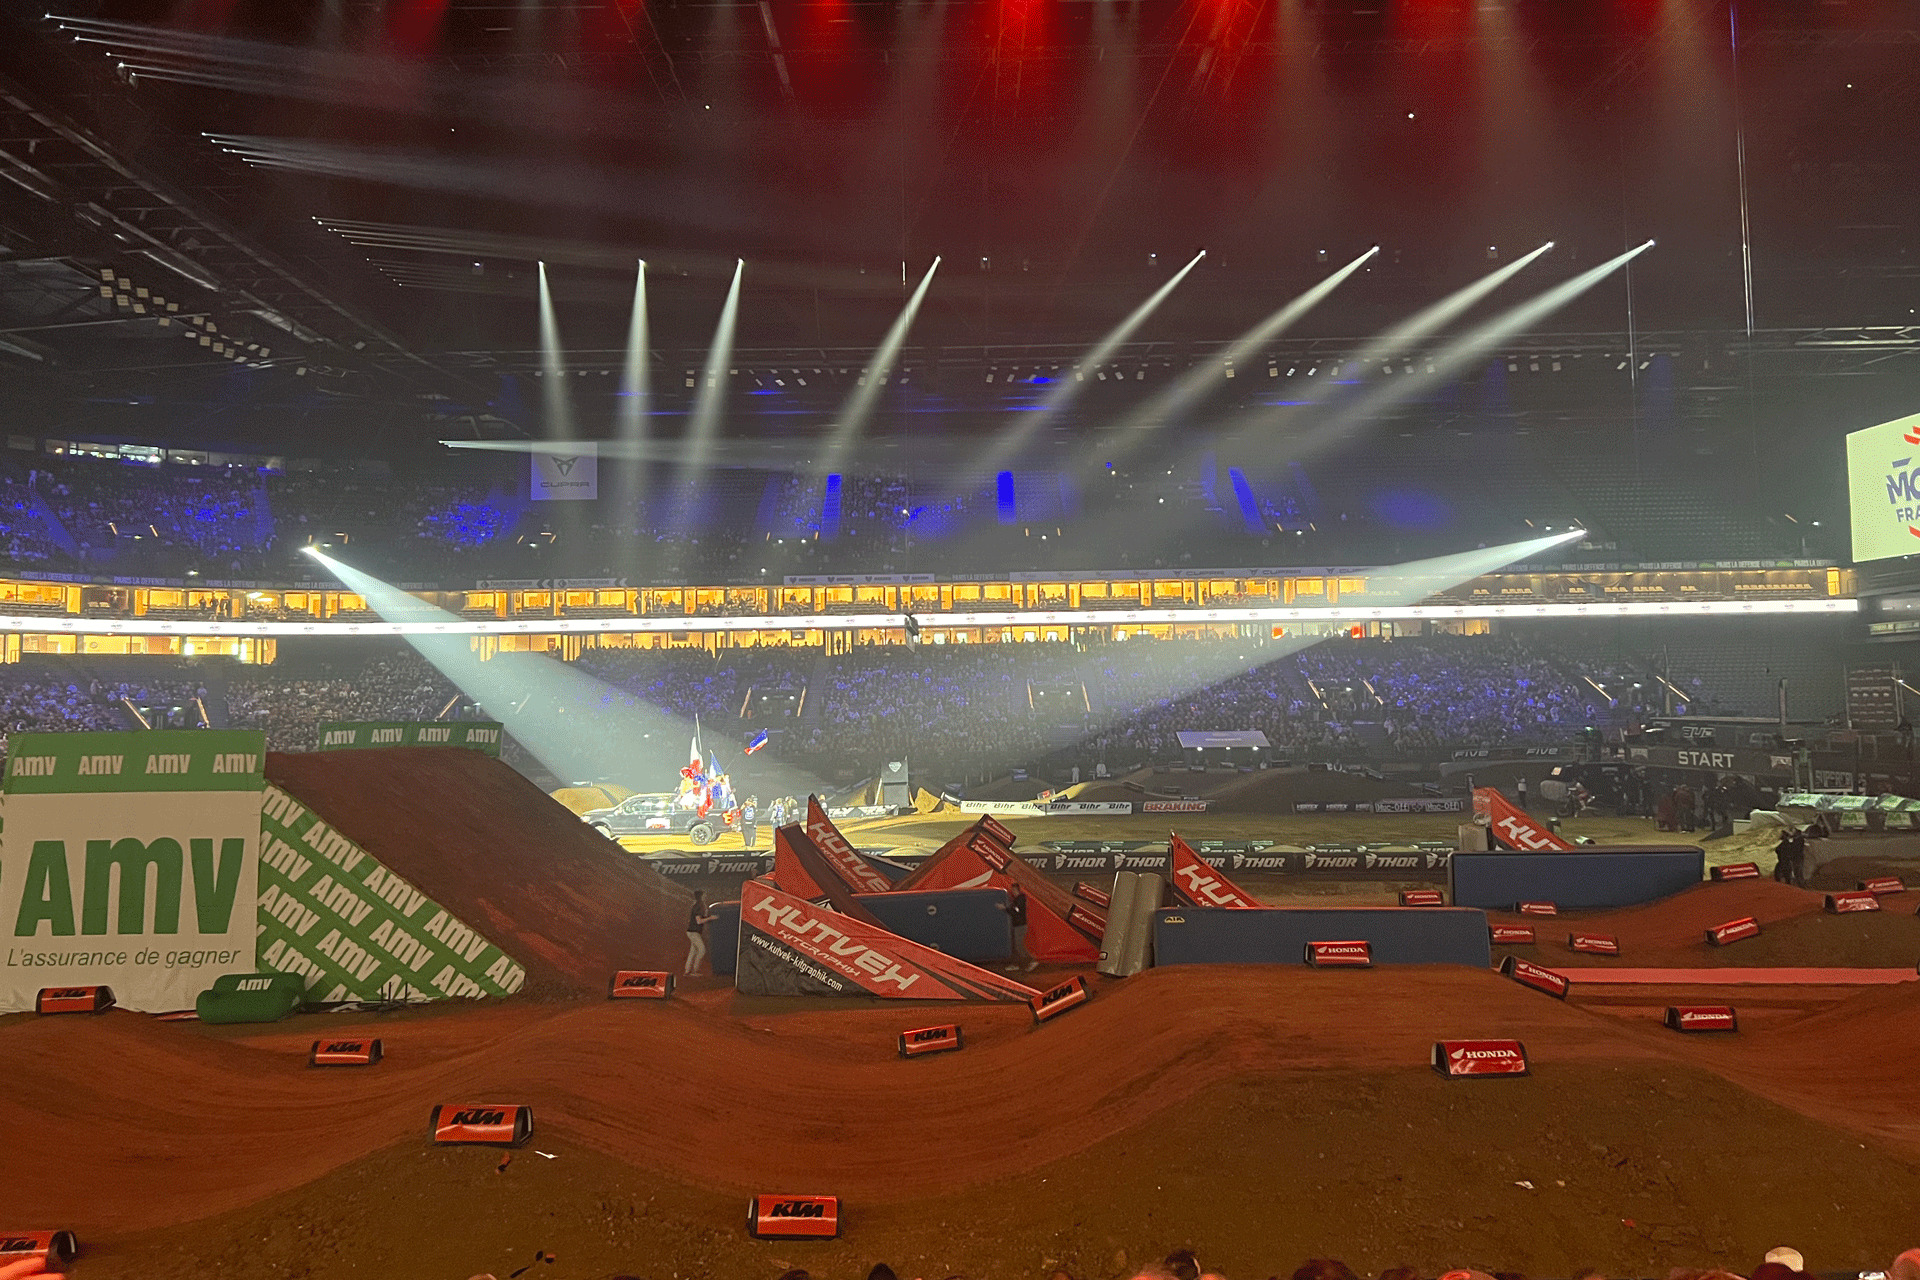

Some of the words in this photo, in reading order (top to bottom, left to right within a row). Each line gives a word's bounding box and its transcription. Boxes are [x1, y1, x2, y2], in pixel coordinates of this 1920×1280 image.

[1738, 560, 1760, 568] DEFENSE
[1794, 559, 1809, 567] PARIS
[1455, 750, 1489, 758] FIVE
[1526, 747, 1559, 756] FIVE
[1678, 751, 1734, 768] START
[1144, 801, 1207, 812] BRAKING
[982, 844, 1004, 863] HONDA
[719, 862, 758, 873] THOR
[1066, 857, 1107, 868] THOR
[1126, 857, 1166, 867] THOR
[1245, 857, 1285, 868] THOR
[1317, 857, 1358, 867] THOR
[1377, 857, 1418, 867] THOR
[662, 863, 701, 874] THOR
[7, 948, 127, 967] L'assurance
[135, 947, 160, 965] de
[165, 949, 242, 969] gagner
[751, 934, 843, 992] www.kutvek-kitgraphik.com
[1528, 966, 1565, 986] HONDA
[1042, 984, 1072, 1006] KTM
[914, 1029, 947, 1042] KTM
[325, 1041, 362, 1052] KTM
[1465, 1050, 1518, 1059] HONDA
[451, 1109, 505, 1125] KTM
[771, 1200, 825, 1217] KTM
[0, 1237, 38, 1251] TM
